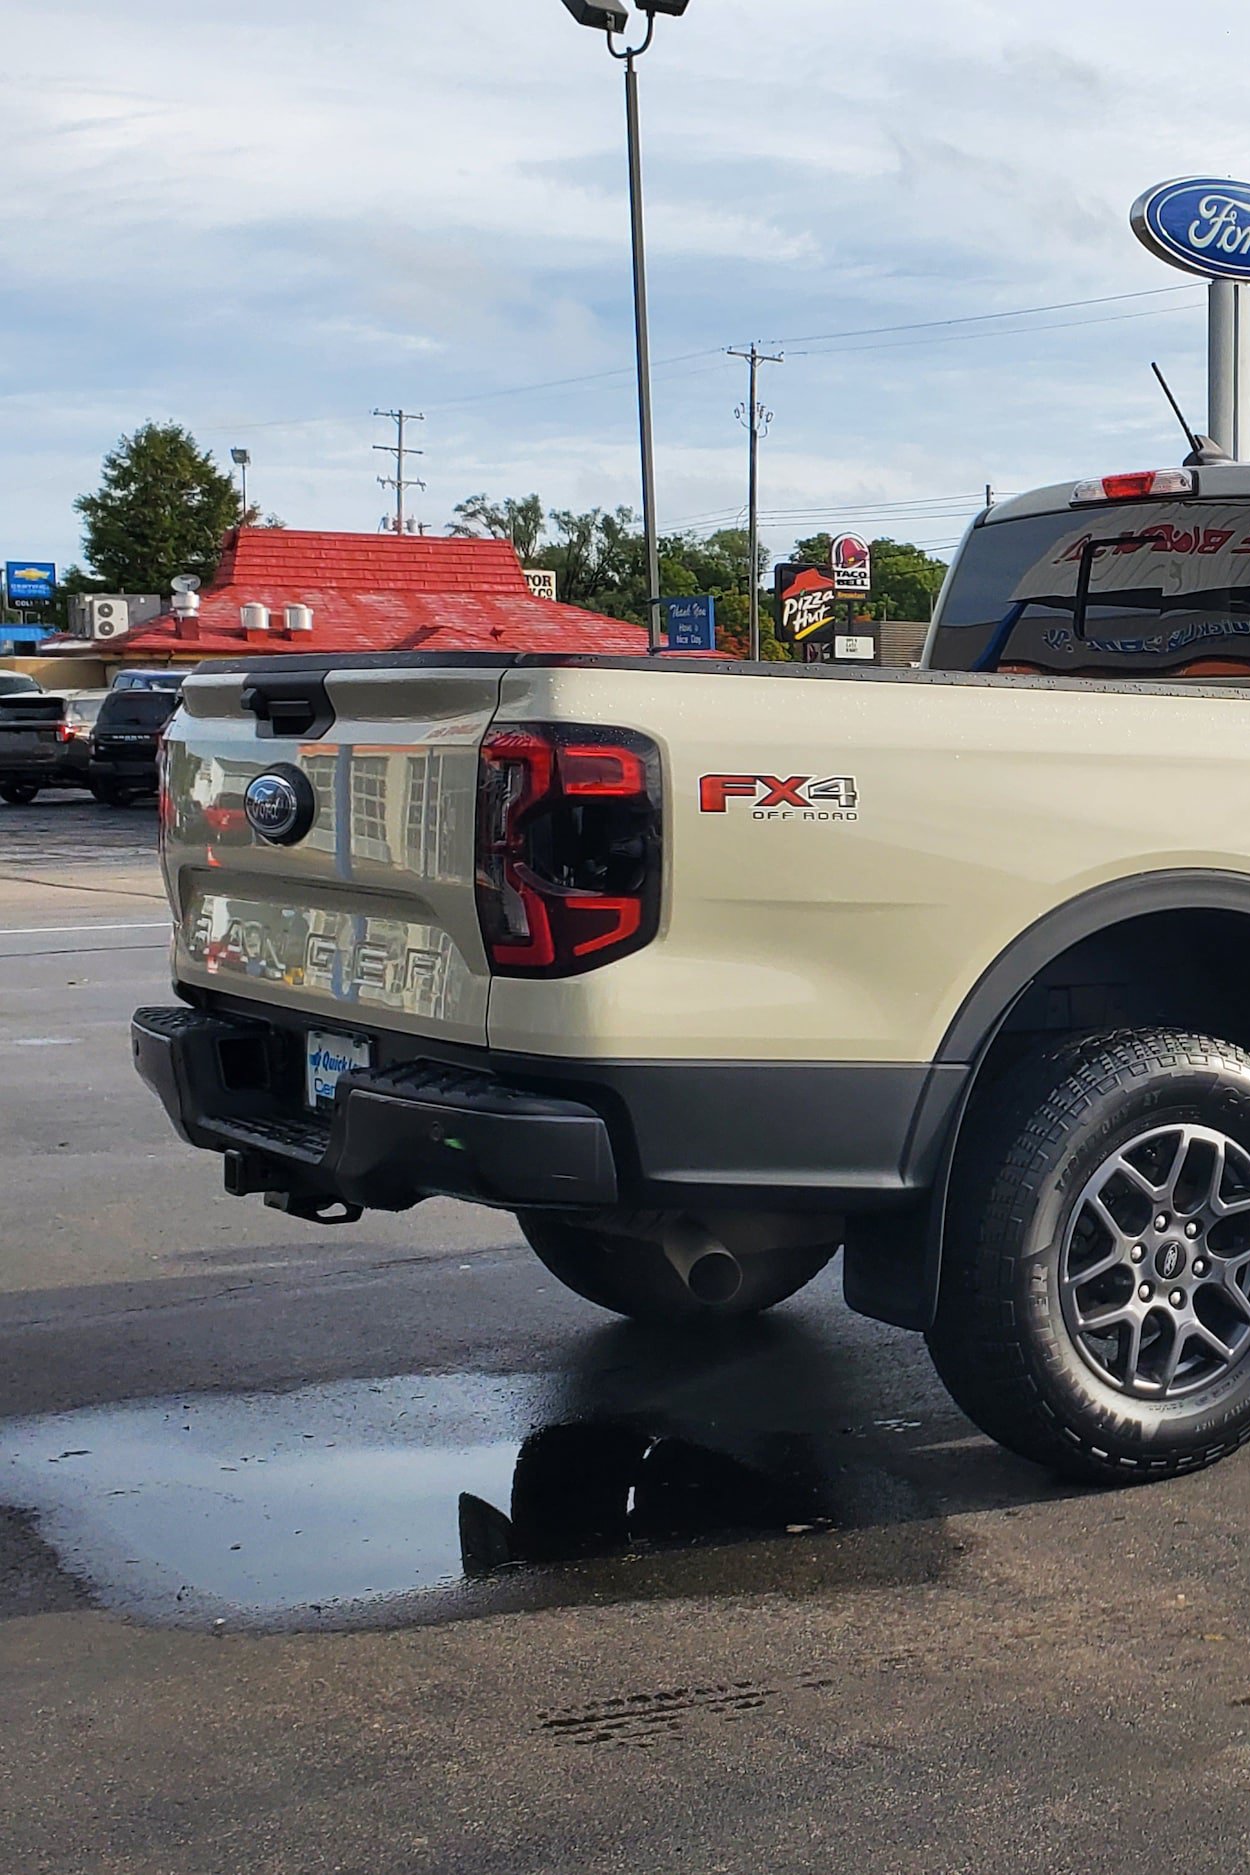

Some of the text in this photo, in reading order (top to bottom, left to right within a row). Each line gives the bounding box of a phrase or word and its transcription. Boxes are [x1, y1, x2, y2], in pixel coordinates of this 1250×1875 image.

[835, 570, 867, 579] TACO
[836, 579, 868, 587] BELL
[669, 602, 706, 618] Thank You
[783, 590, 834, 627] Pizza
[793, 604, 830, 633] Hut
[676, 634, 689, 644] Nice
[251, 787, 281, 820] Ford
[699, 773, 859, 814] FX4
[752, 811, 858, 821] OFF ROAD
[187, 912, 443, 994] RANGER
[322, 1050, 347, 1072] Quick
